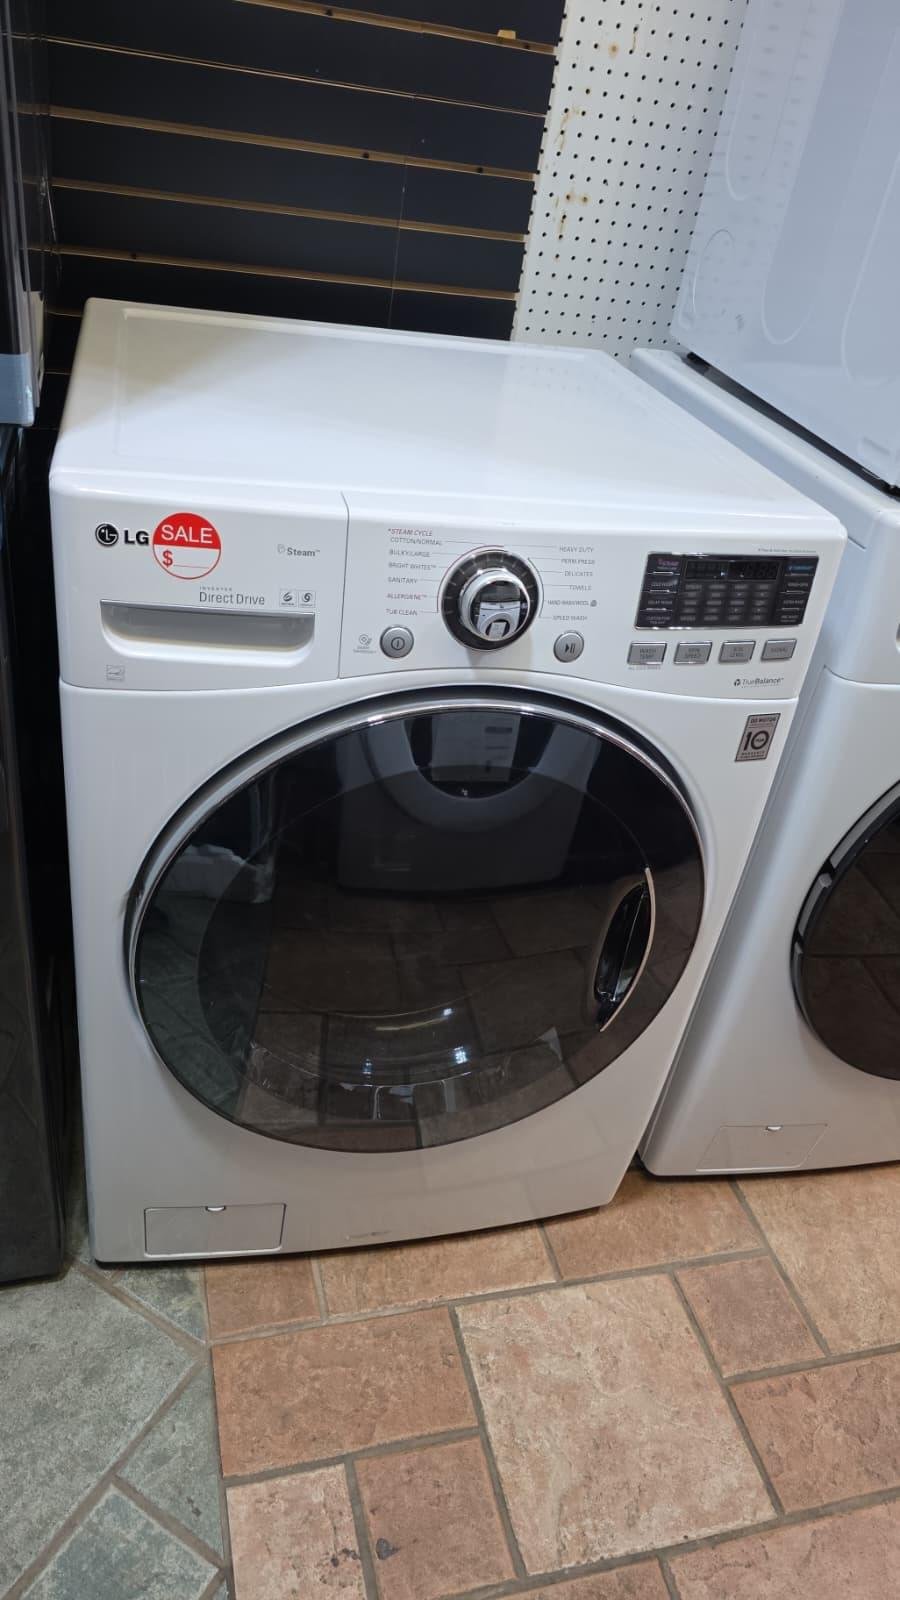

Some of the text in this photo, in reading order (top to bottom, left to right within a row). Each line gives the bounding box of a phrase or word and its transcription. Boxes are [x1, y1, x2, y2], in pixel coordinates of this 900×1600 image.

[123, 529, 150, 546] LG
[161, 524, 214, 544] SALE
[162, 549, 174, 568] $
[387, 576, 418, 584] SANITARY
[199, 591, 266, 606] Direct Drive
[398, 609, 418, 617] CLEAN
[743, 730, 770, 751] 10
